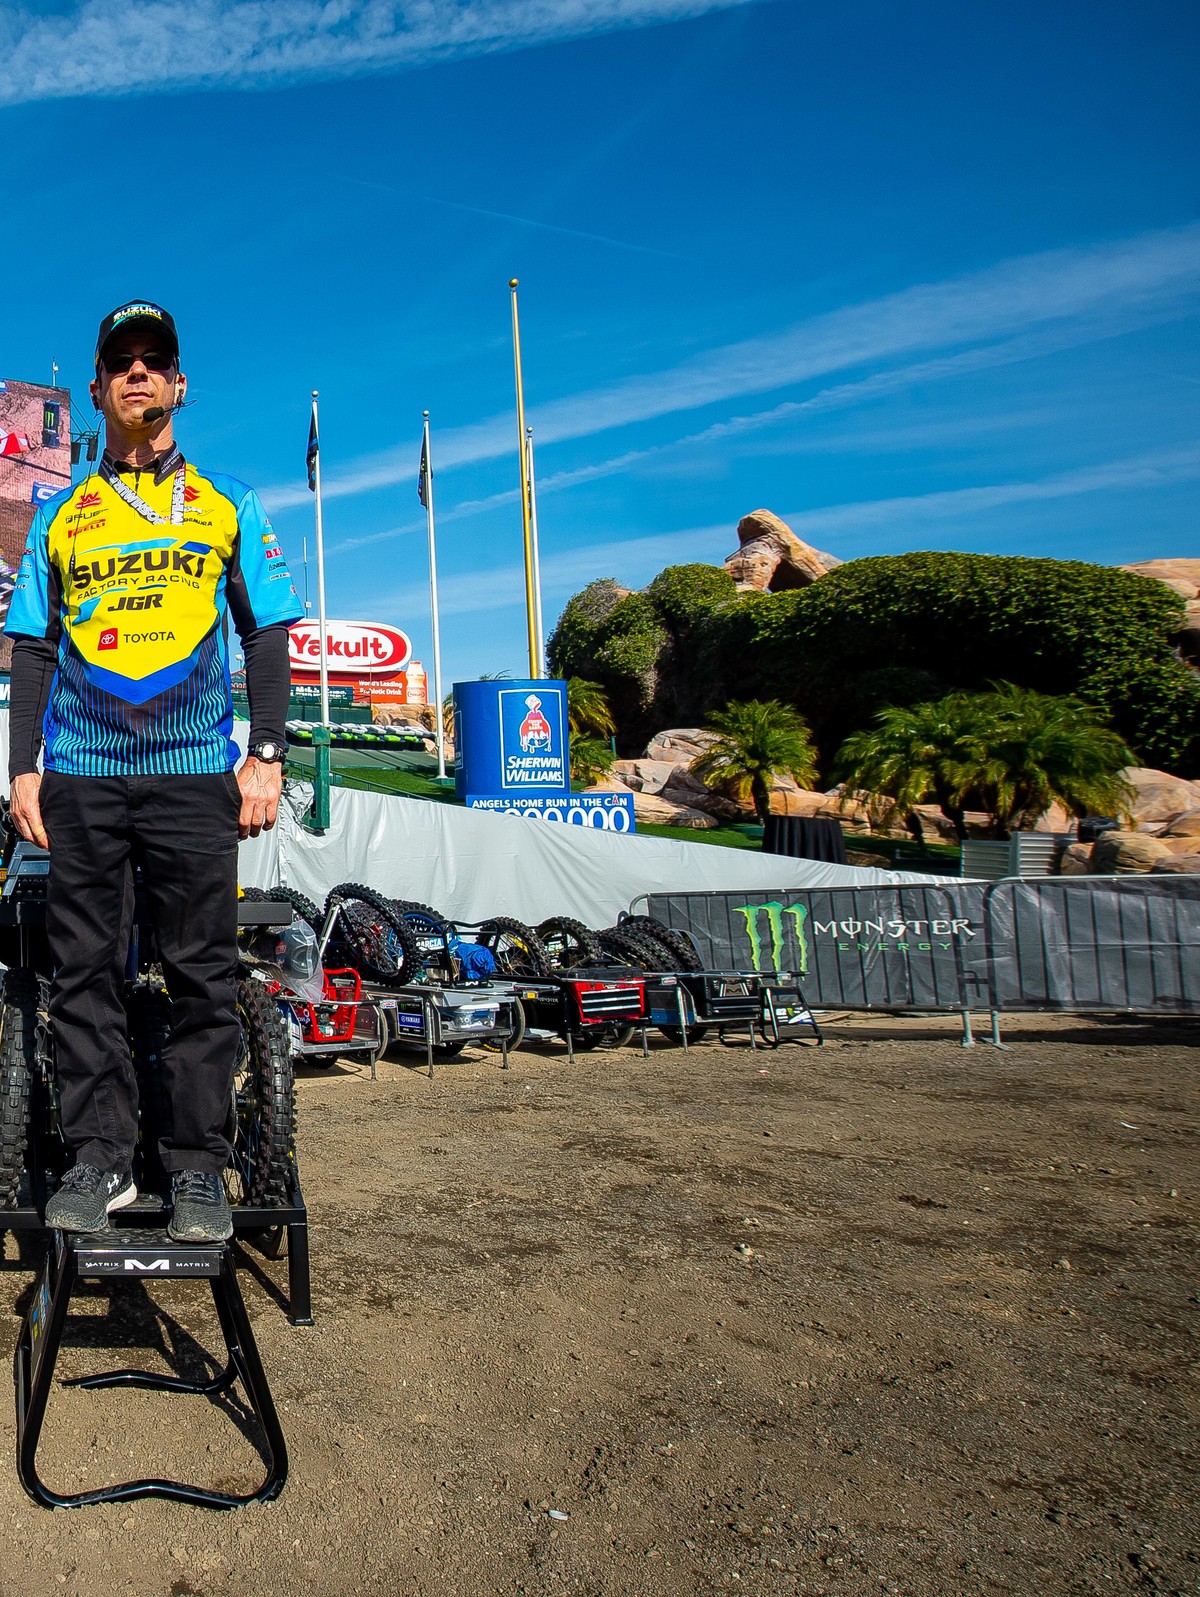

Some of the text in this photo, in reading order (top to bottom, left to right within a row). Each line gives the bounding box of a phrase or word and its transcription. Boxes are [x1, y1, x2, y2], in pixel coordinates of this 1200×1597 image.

[113, 305, 161, 321] SUZUKI
[73, 550, 206, 590] SUZUKI
[77, 574, 200, 600] FACTORY RACING
[107, 593, 164, 612] JGR
[123, 631, 176, 643] TOYOTA
[290, 633, 387, 659] Yakult
[472, 800, 510, 809] ANGELS
[513, 799, 543, 808] HOME
[546, 799, 567, 807] RUN
[569, 799, 580, 807] IN
[813, 916, 976, 941] MONSTER
[839, 942, 951, 951] ENERGY
